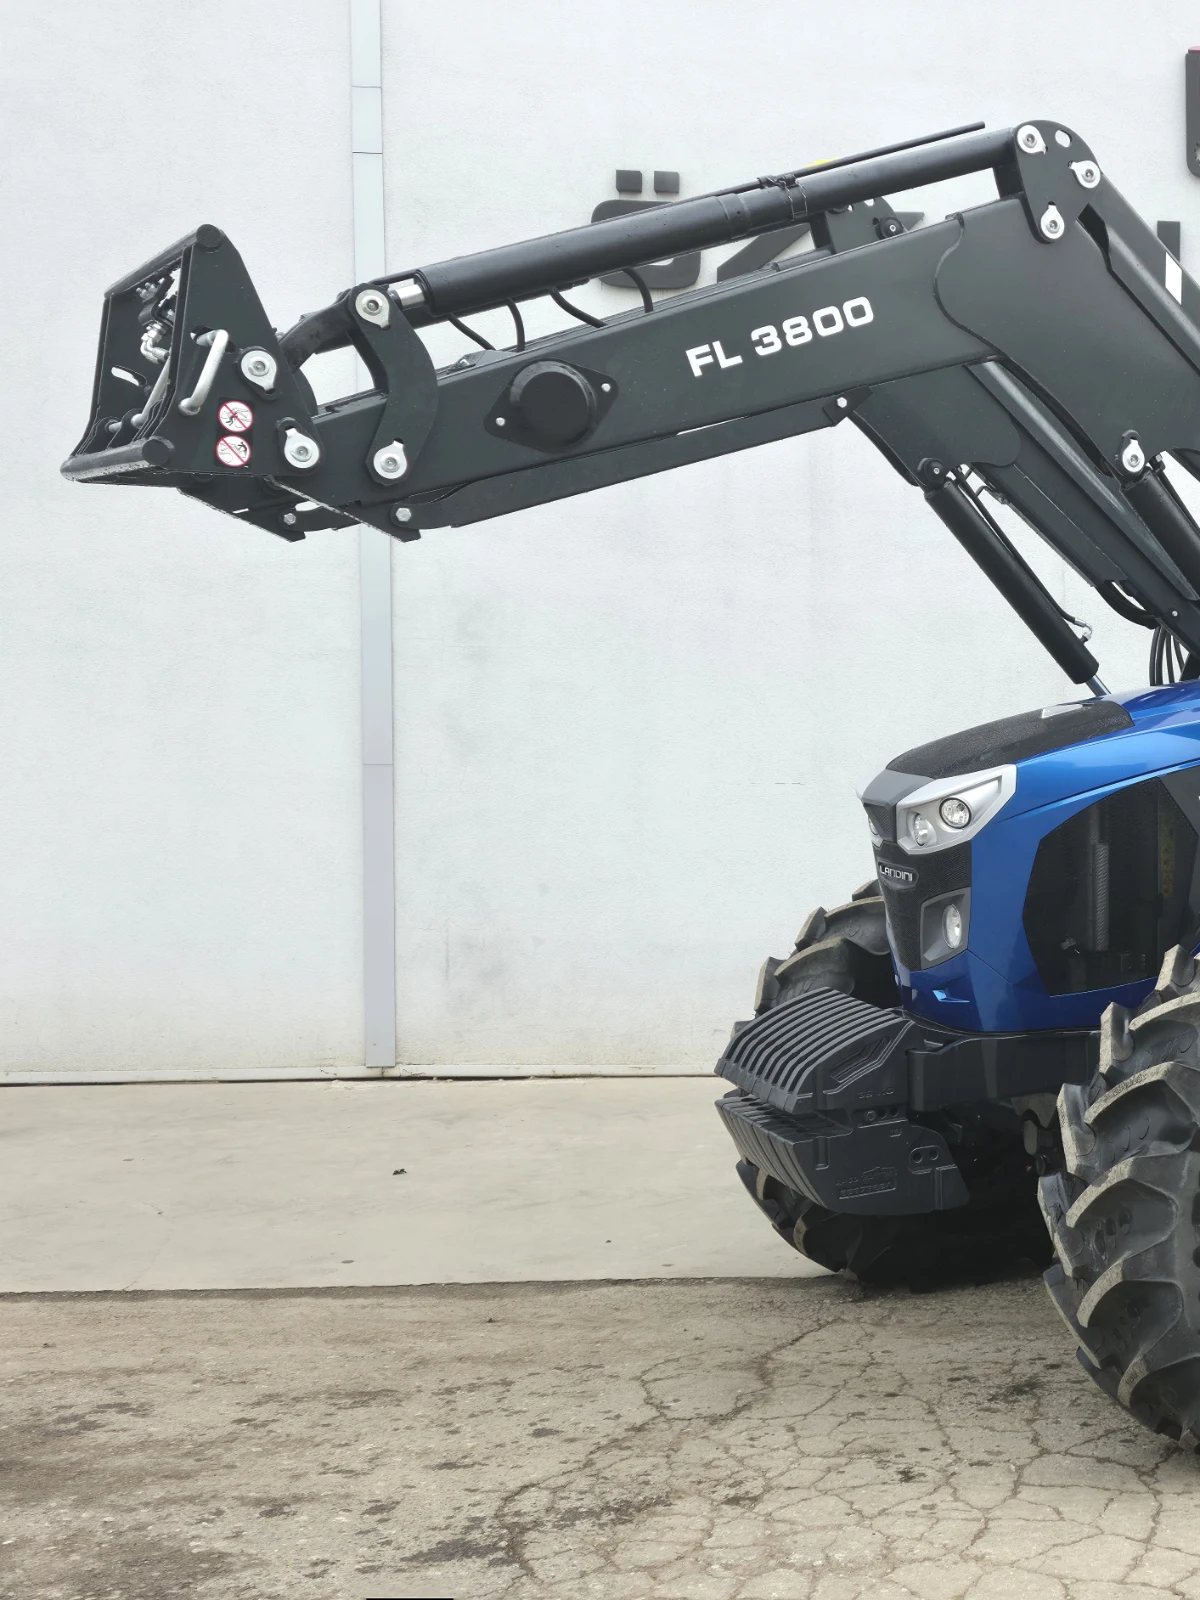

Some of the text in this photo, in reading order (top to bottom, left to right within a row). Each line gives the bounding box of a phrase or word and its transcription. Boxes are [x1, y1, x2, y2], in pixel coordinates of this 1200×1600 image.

[685, 296, 874, 378] FL 3800
[879, 865, 913, 881] LANDINI
